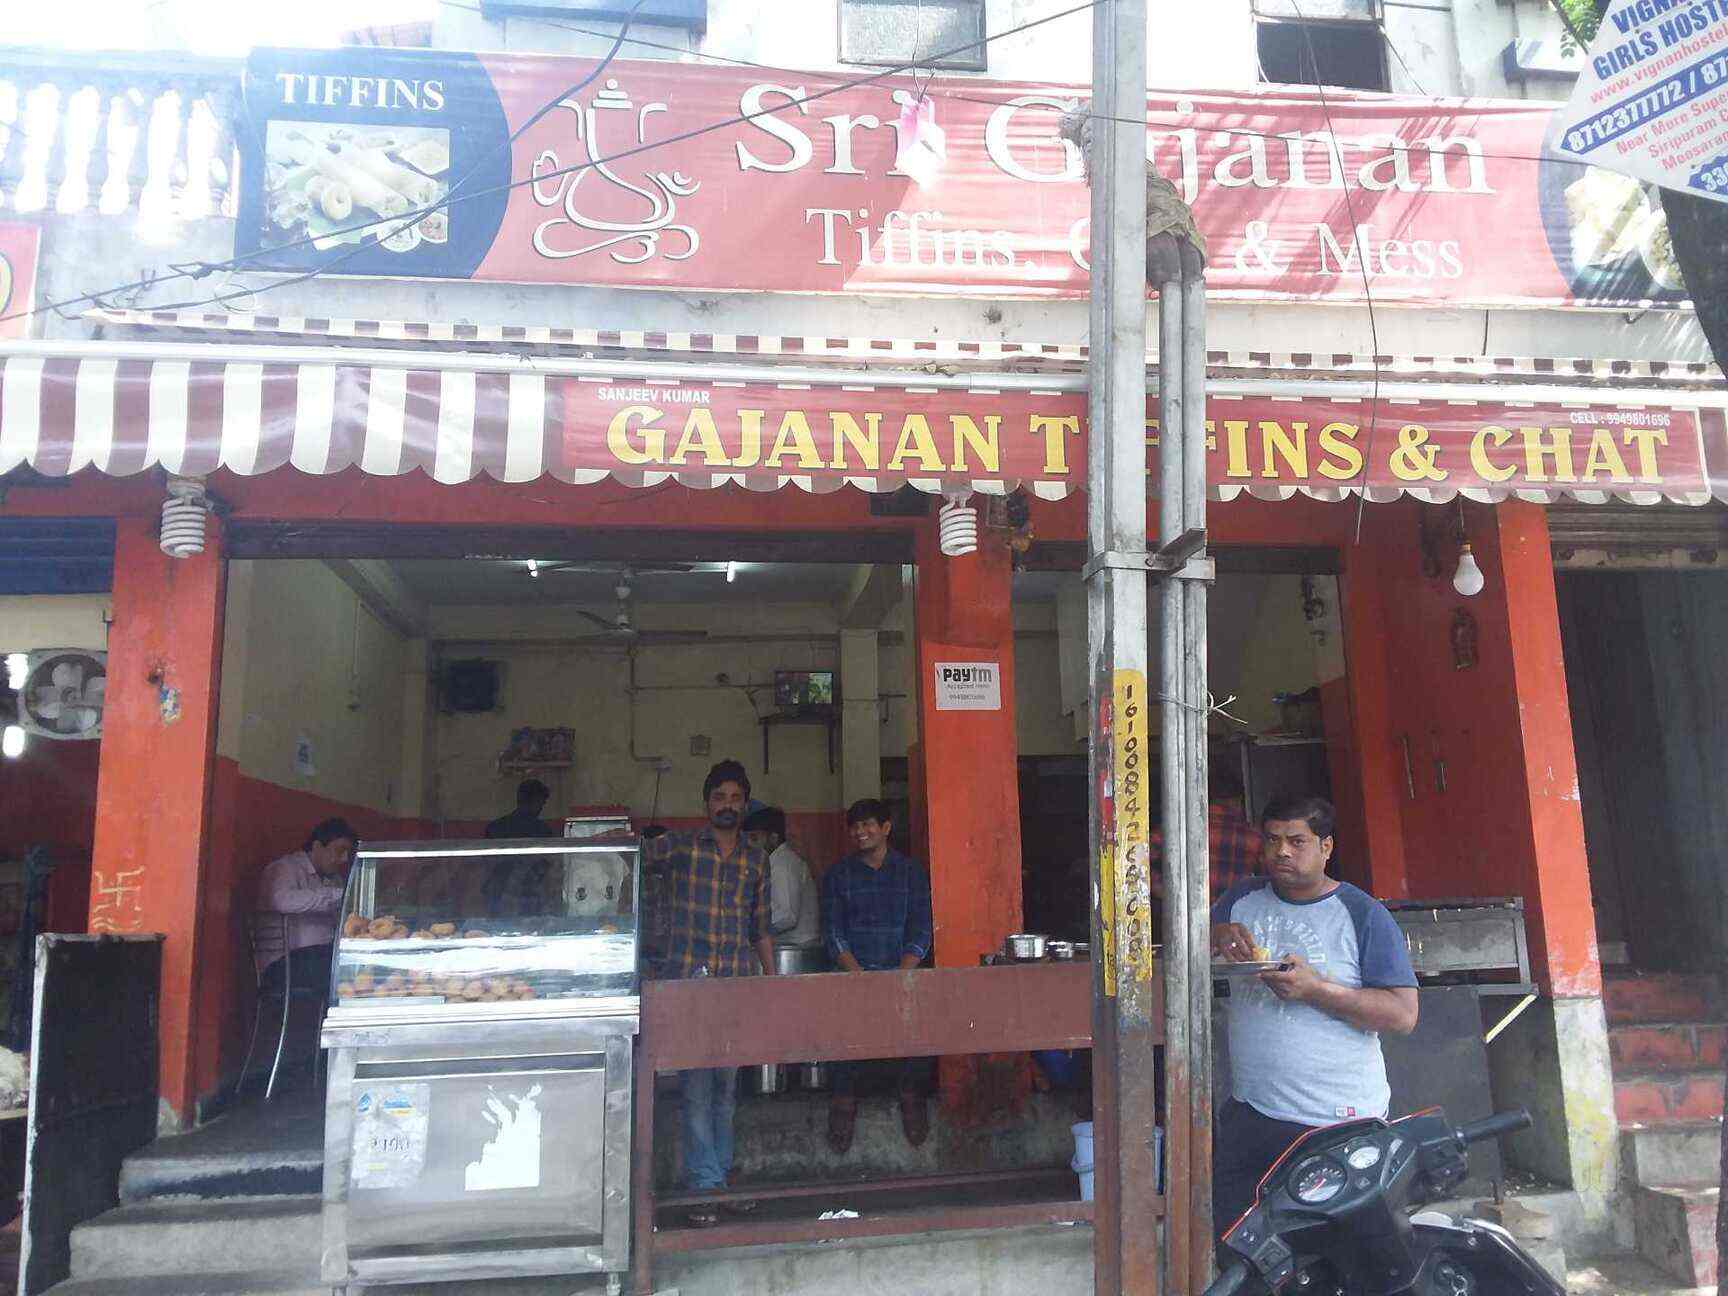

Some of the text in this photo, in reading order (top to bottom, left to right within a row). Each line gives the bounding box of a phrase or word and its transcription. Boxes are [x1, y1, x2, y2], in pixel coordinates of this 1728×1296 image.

[1611, 0, 1686, 34] VIGN
[1592, 31, 1659, 81] GIRLS
[277, 73, 445, 111] TIFFINS
[1567, 80, 1685, 152] 8712377772
[1700, 56, 1728, 85] 87
[1690, 90, 1728, 117] Supe
[735, 83, 1498, 206] Sri Gjanan
[1233, 219, 1291, 275] &
[1315, 222, 1463, 279] Mess
[598, 386, 710, 404] SANJEEV KUMAR
[606, 404, 1670, 484] GAJANAN TINS & CHAT
